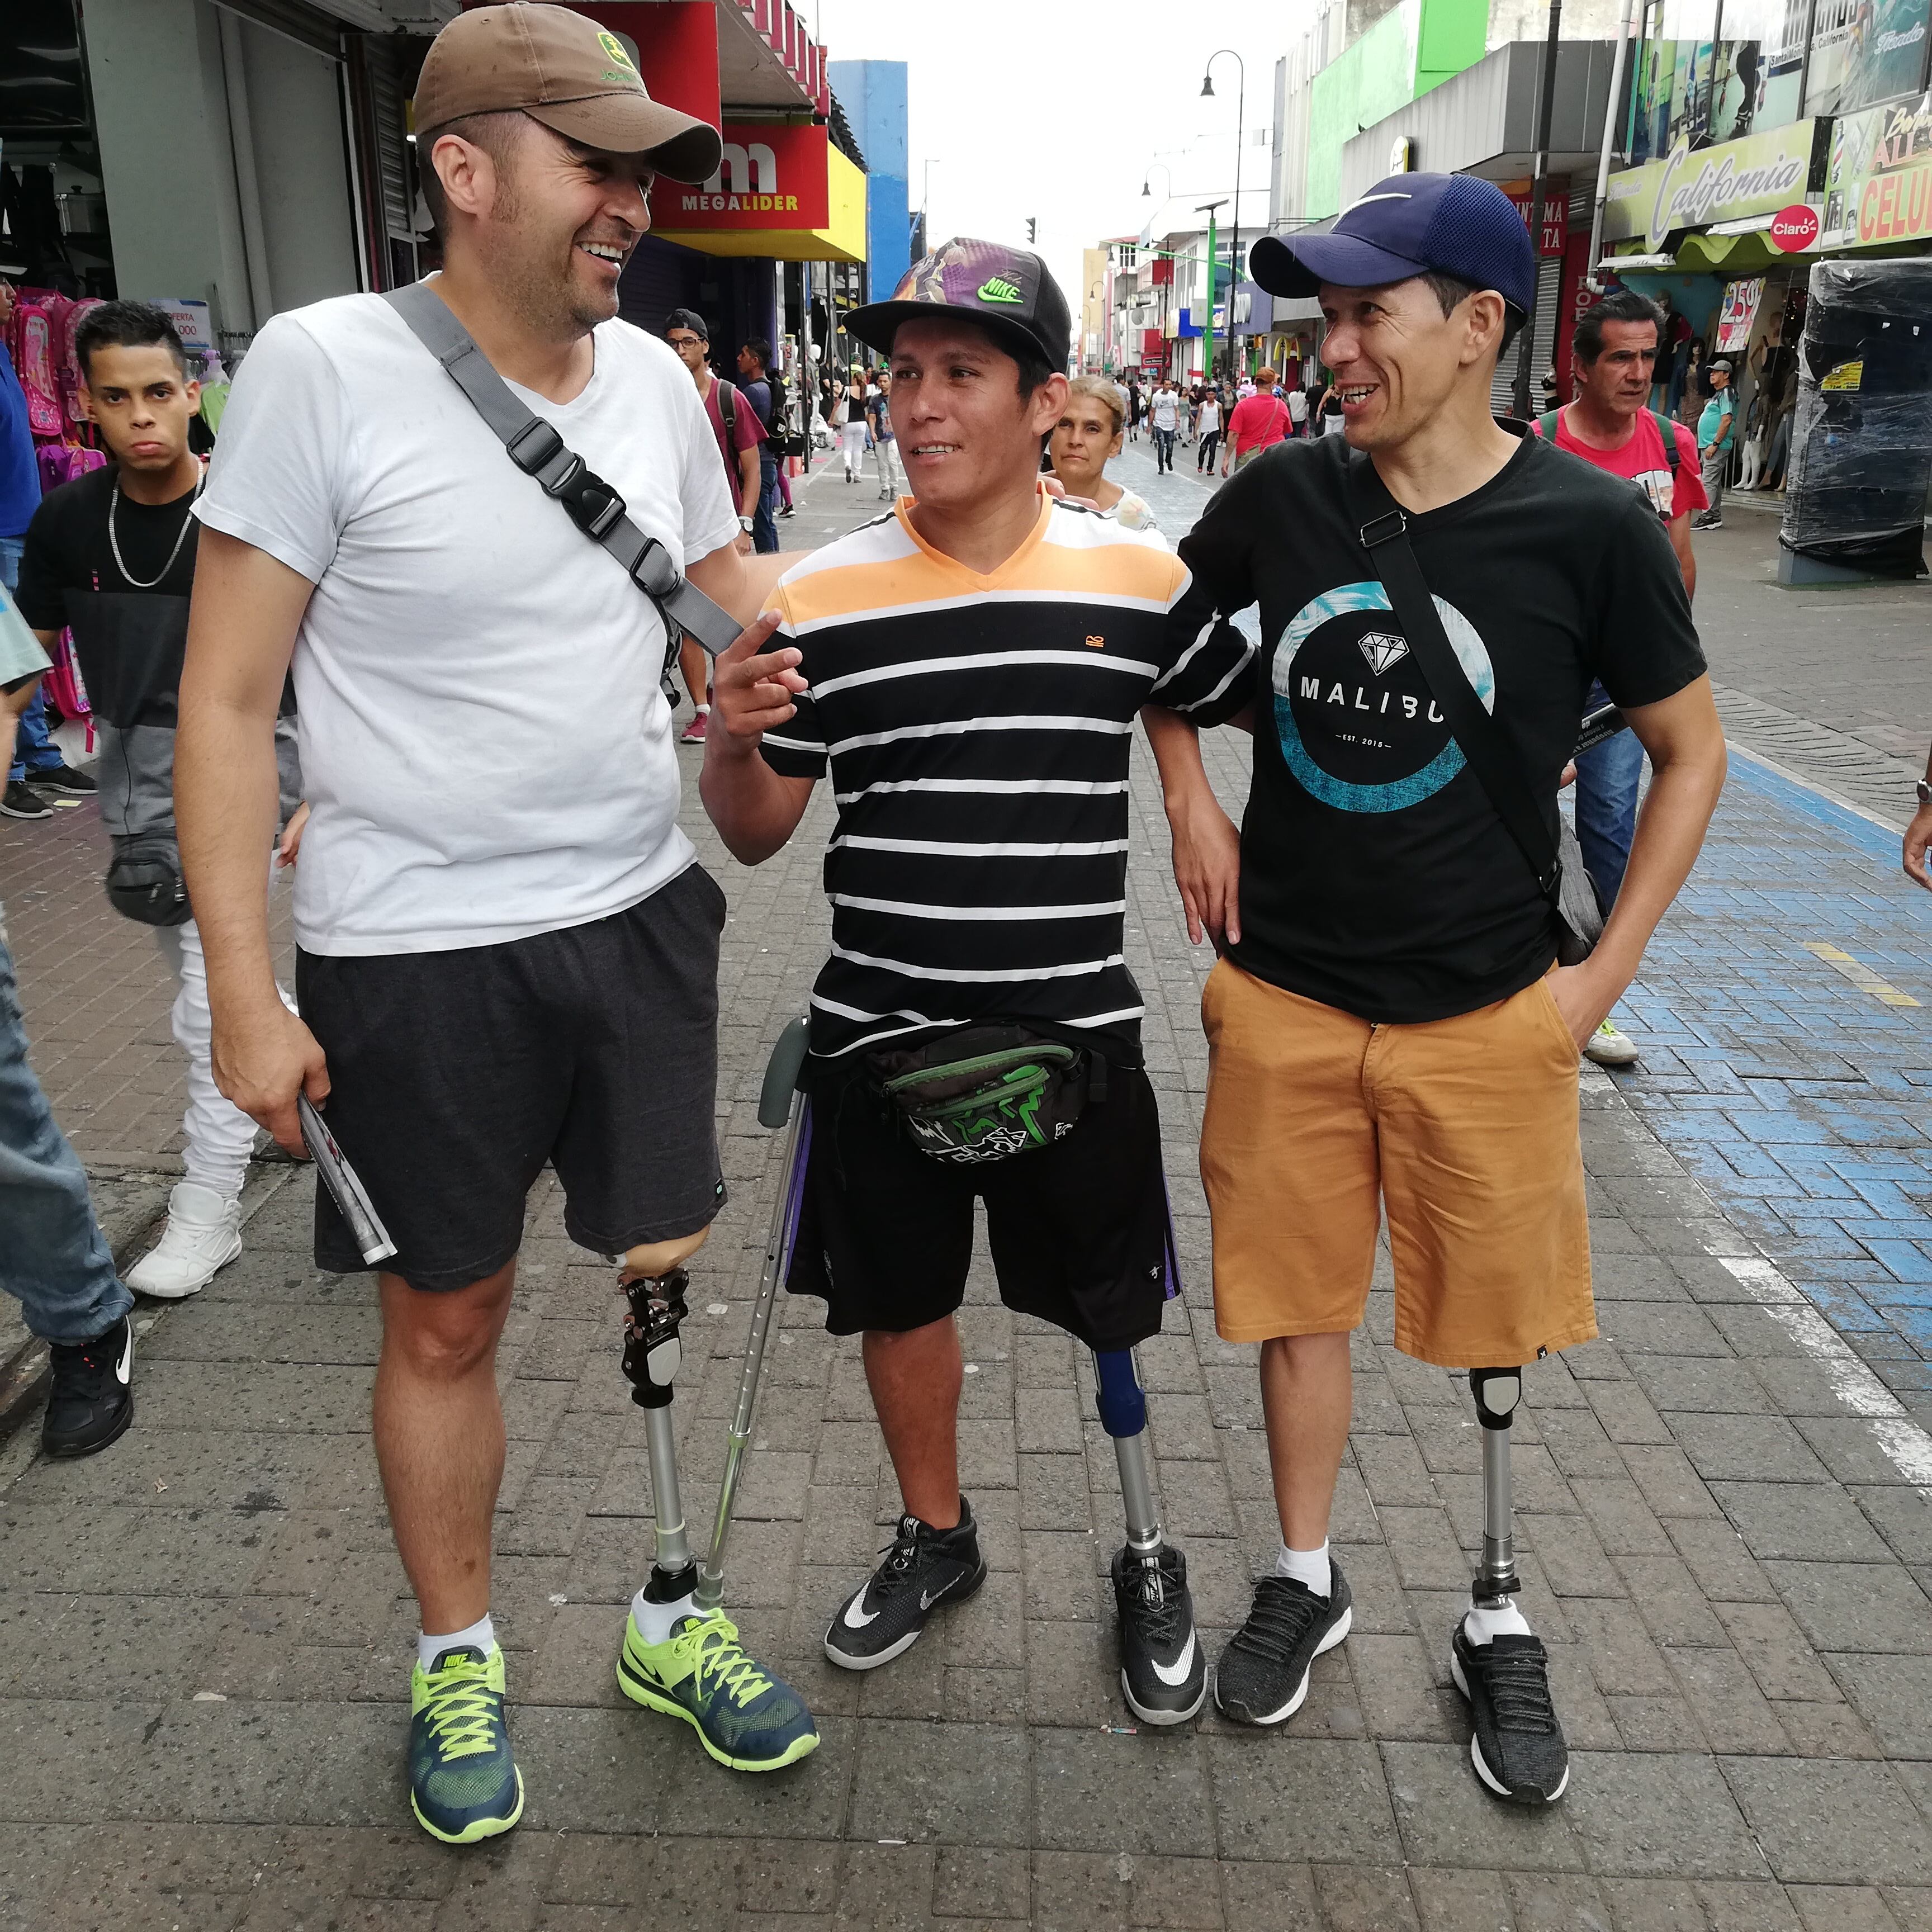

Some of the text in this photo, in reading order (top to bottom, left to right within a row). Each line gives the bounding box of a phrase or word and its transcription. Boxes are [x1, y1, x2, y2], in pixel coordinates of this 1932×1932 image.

[1819, 31, 1848, 49] California
[682, 195, 798, 211] MEGALIDER
[1651, 146, 1805, 243] California
[1773, 222, 1810, 235] Claro
[984, 277, 1020, 300] NIKE
[1300, 676, 1444, 723] MALIBU
[443, 1654, 468, 1668] NIKE
